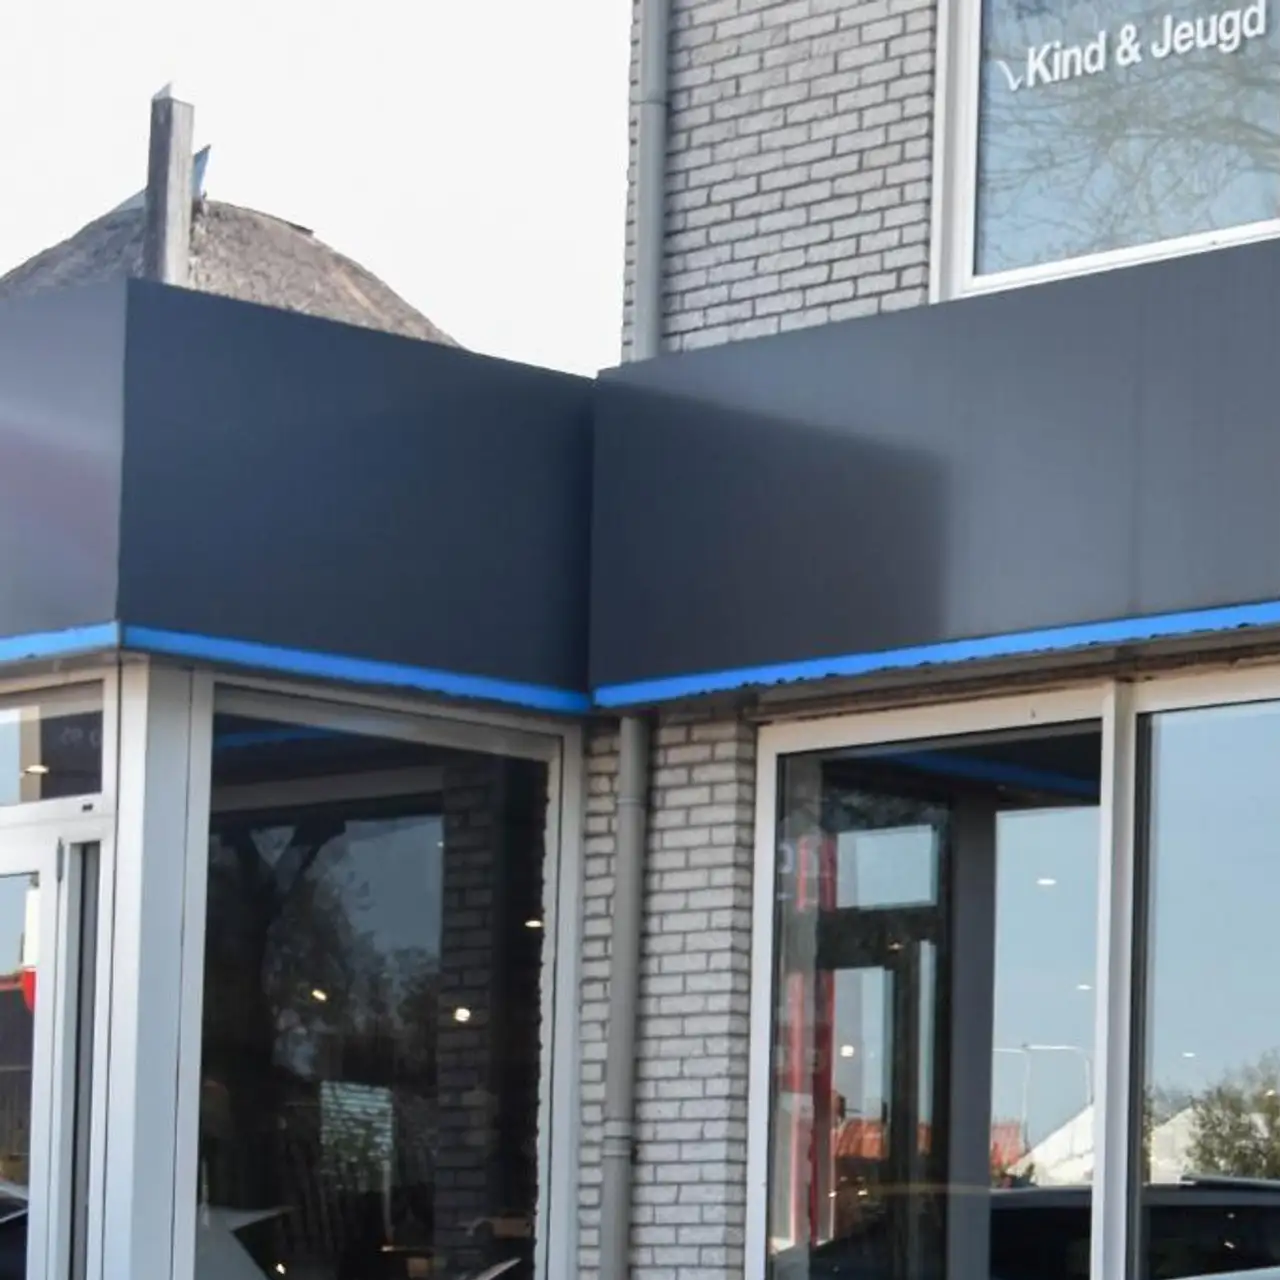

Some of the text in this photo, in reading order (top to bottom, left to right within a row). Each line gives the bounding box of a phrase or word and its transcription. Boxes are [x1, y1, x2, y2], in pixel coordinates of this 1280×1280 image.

[1026, 0, 1267, 88] Kind & Jeugd
